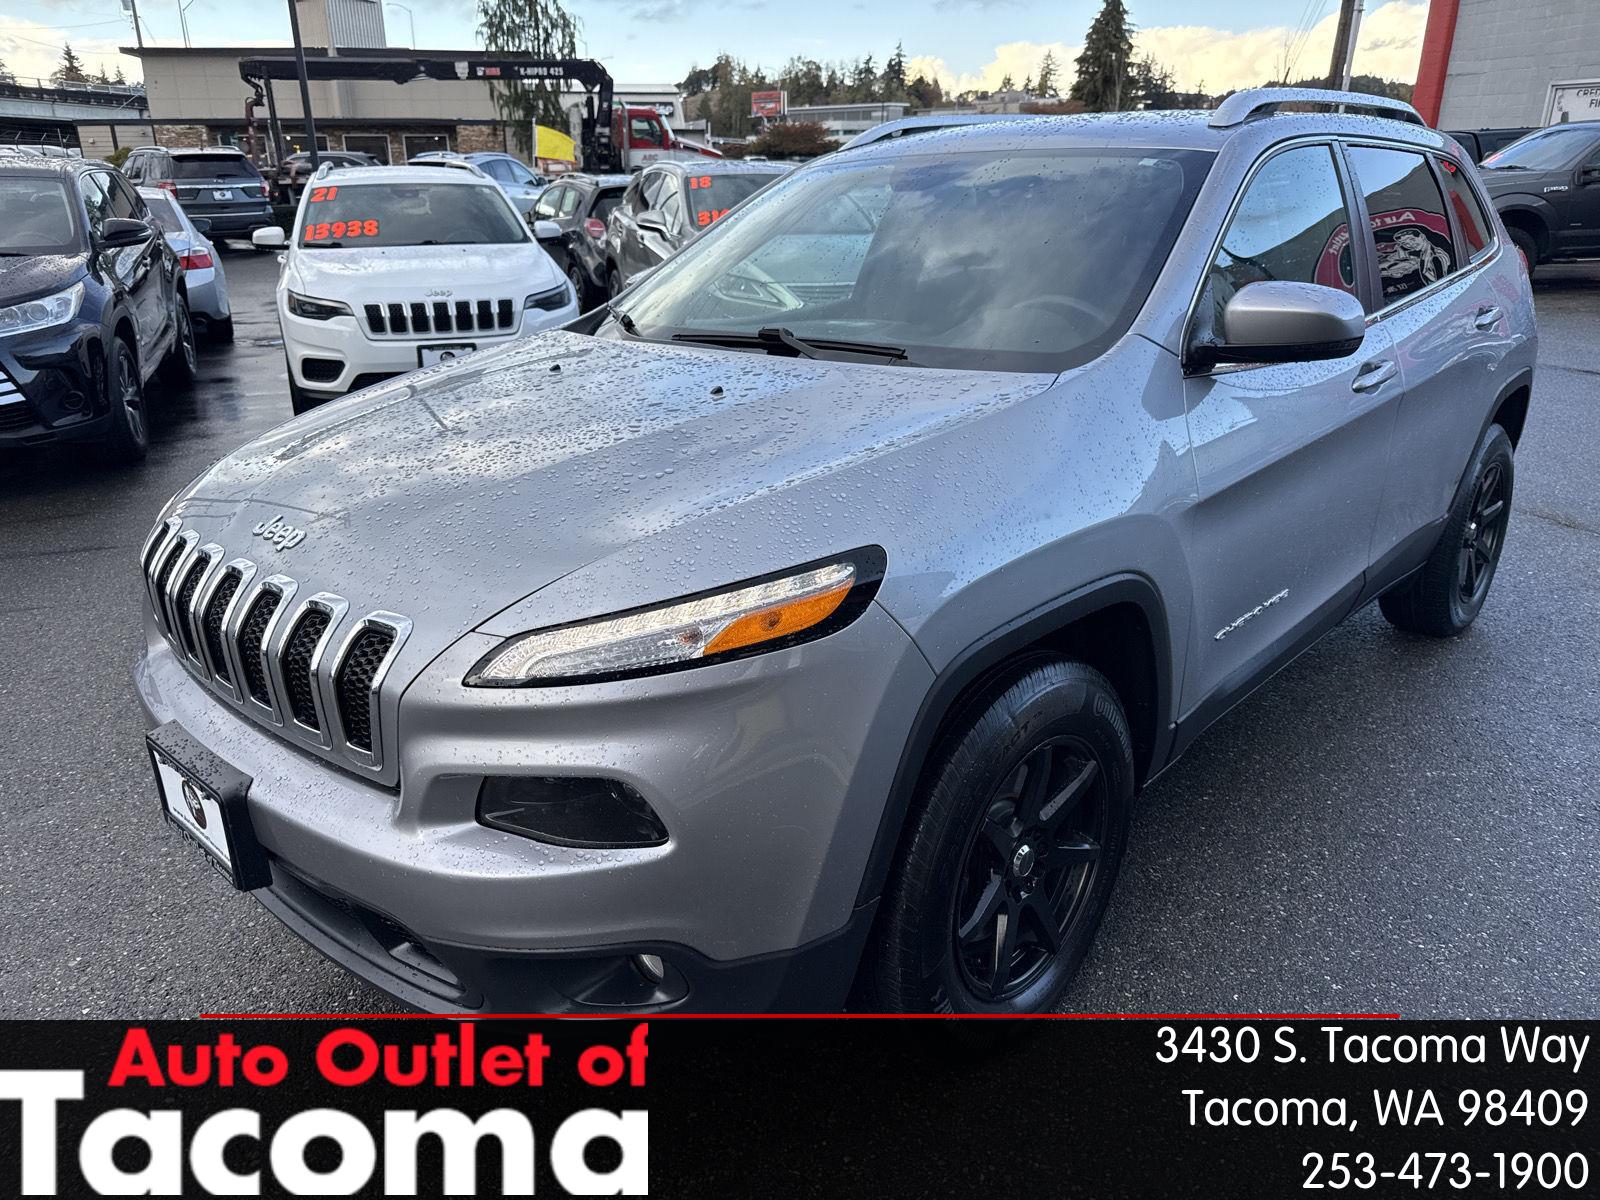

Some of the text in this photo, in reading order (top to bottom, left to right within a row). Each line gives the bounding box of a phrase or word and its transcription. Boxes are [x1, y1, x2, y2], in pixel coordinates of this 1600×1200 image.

[690, 175, 711, 189] 18
[310, 187, 337, 202] 21
[304, 219, 378, 241] 13938
[252, 514, 307, 552] Jeep
